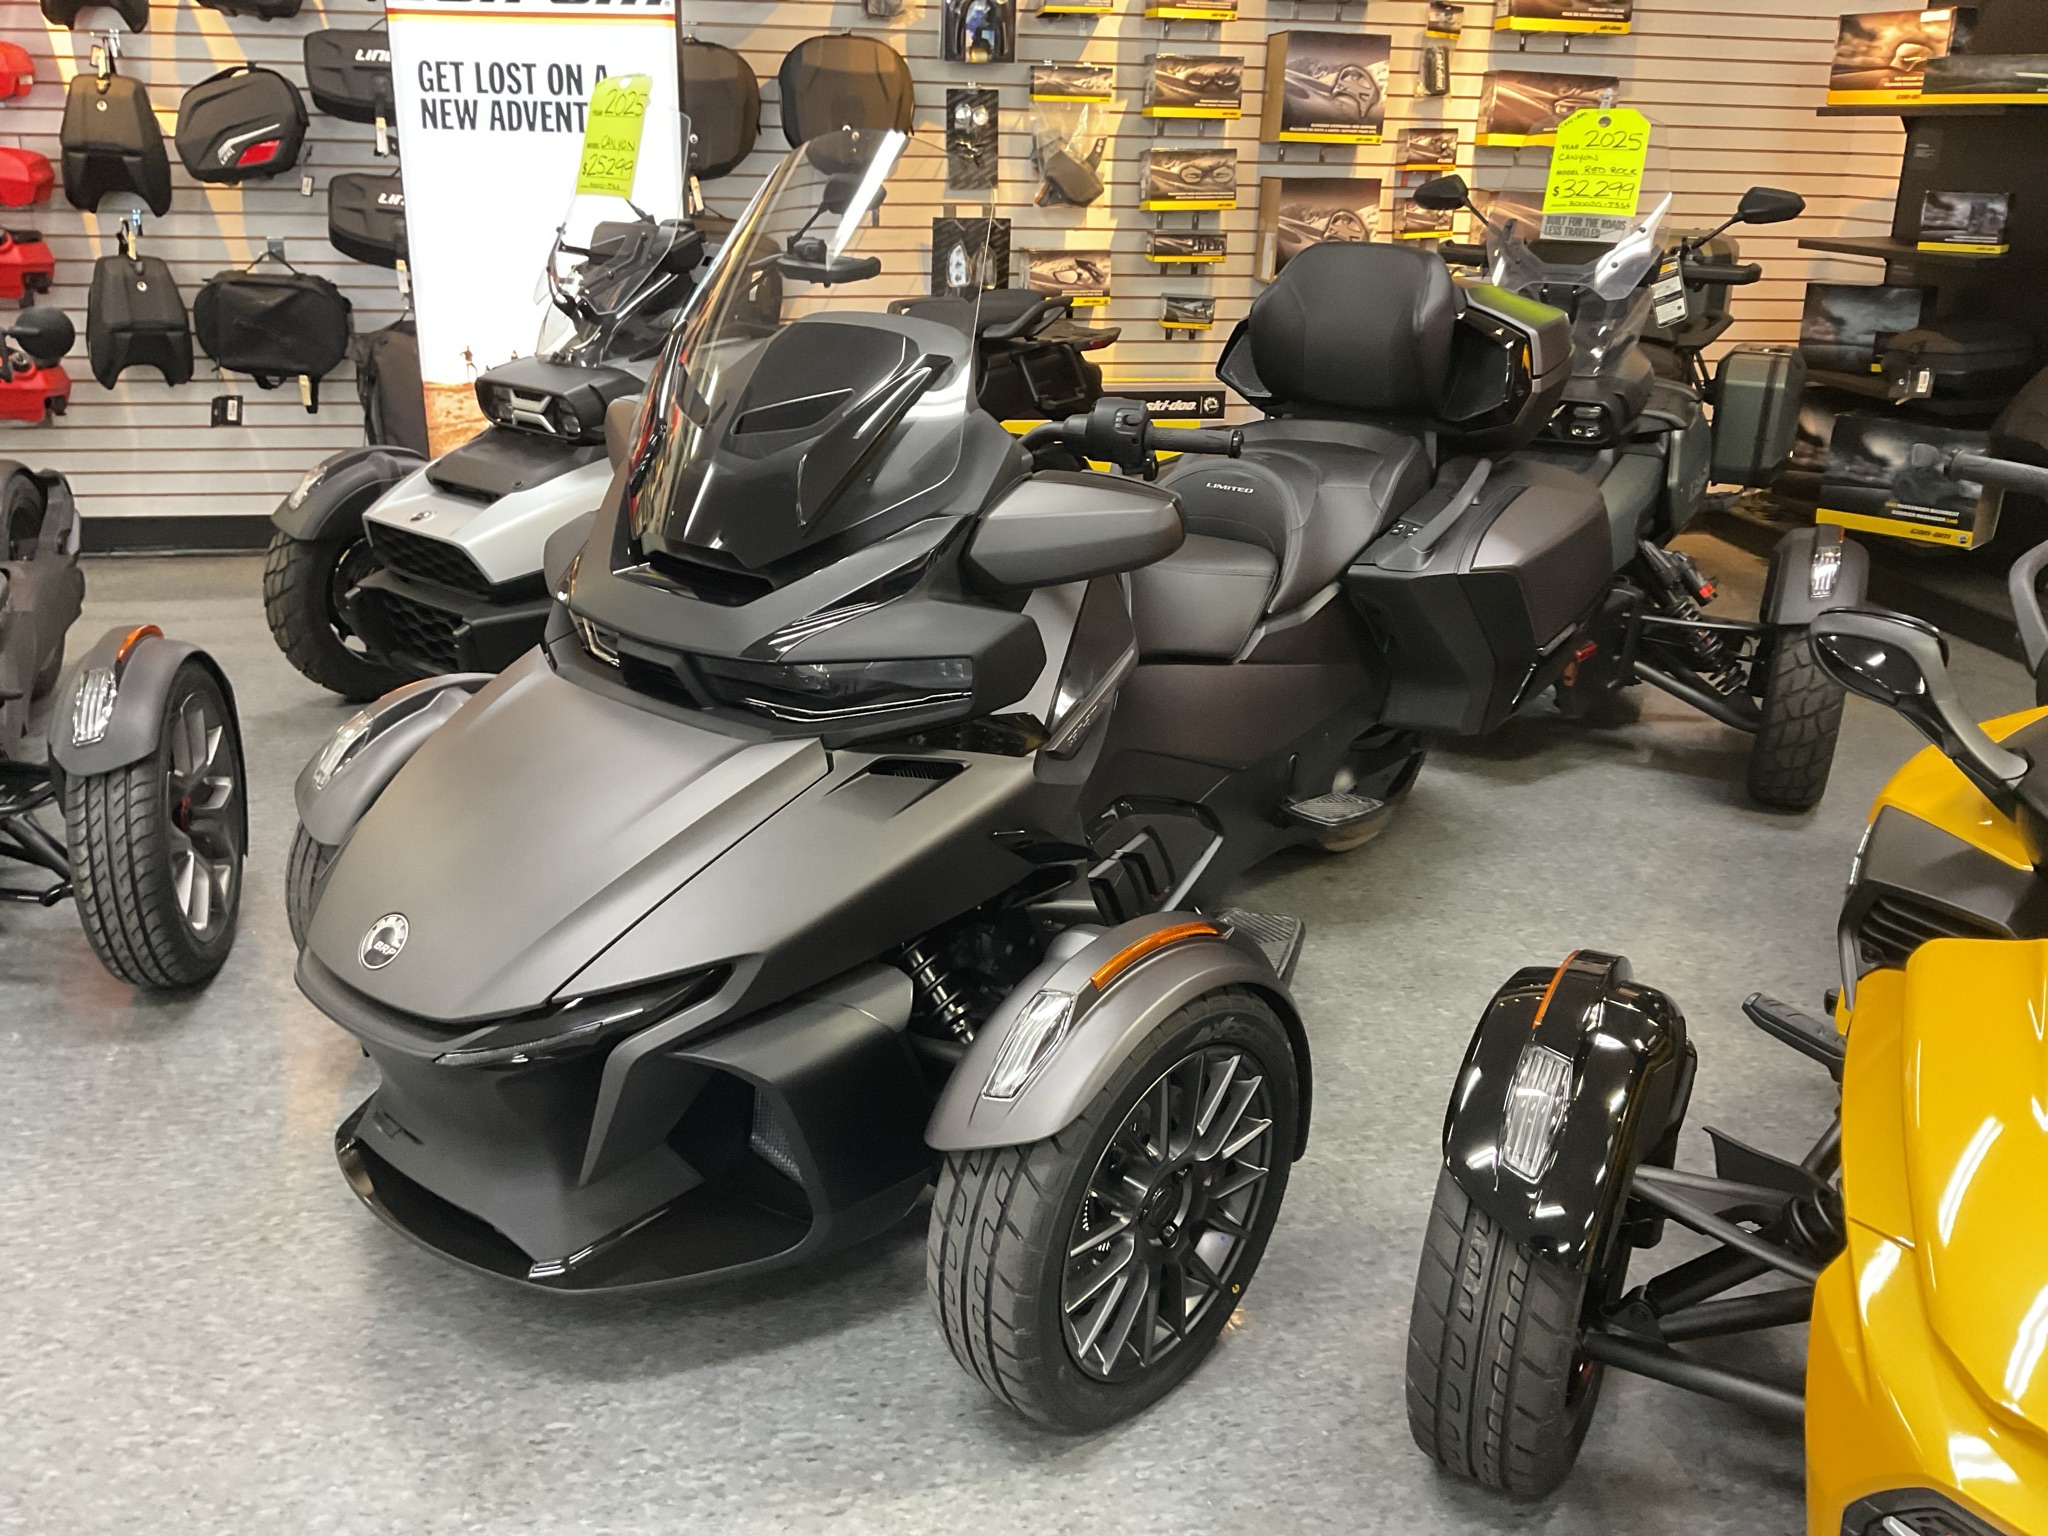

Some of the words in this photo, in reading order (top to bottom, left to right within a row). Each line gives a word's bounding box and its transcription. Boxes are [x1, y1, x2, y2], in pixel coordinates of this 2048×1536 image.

[355, 49, 391, 62] LIN
[418, 61, 463, 93] GET
[475, 62, 536, 95] LOST
[548, 64, 583, 96] ON
[605, 89, 647, 116] 2025
[421, 99, 477, 131] NEW
[490, 101, 588, 133] ADVENT
[1584, 130, 1644, 151] 2025
[1558, 153, 1599, 163] CANYON
[1584, 166, 1607, 174] RED
[1610, 167, 1638, 176] ROCK
[1546, 215, 1566, 226] BUILT
[1568, 217, 1583, 227] FOR
[1585, 218, 1599, 228] THE
[1601, 219, 1627, 231] ROADS
[1544, 226, 1561, 236] LESS
[1564, 227, 1601, 239] TRAVELED
[1146, 400, 1196, 411] ski-doo
[1206, 483, 1254, 494] LIMITED
[1910, 528, 1952, 539] can-am
[373, 940, 397, 955] BRP
